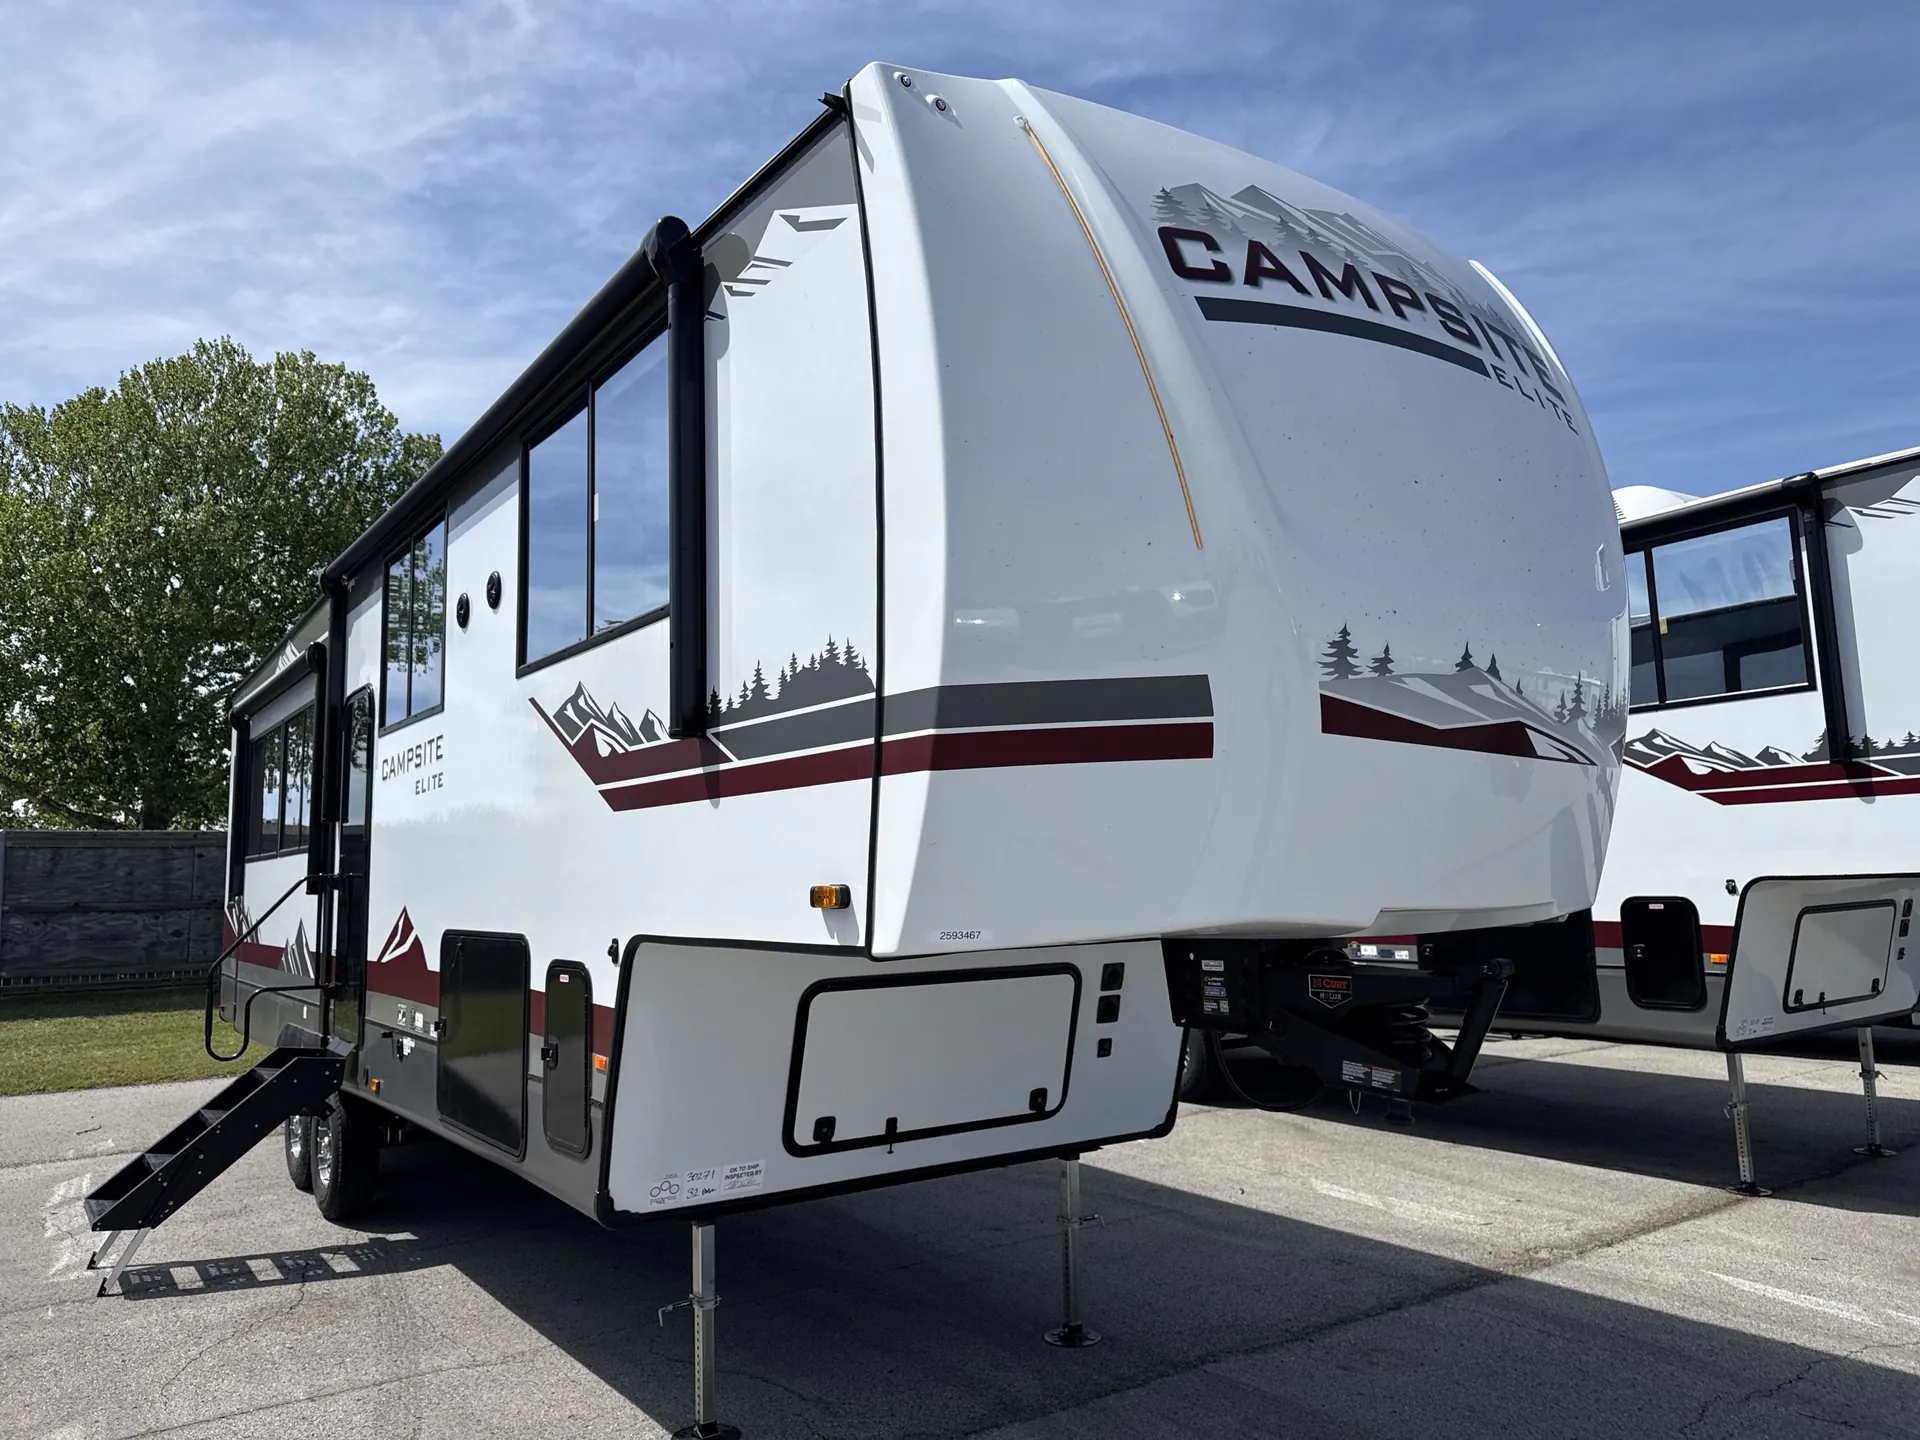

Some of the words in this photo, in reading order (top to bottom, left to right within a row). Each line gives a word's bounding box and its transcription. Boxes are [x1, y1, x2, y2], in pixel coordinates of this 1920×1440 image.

[1157, 226, 1567, 406] CAMPSITE
[1489, 363, 1579, 436] ELITE
[381, 734, 444, 782] CAMPSITE
[415, 771, 444, 796] ELITE
[939, 930, 982, 941] 2593467
[724, 1170, 755, 1180] INSPECTED
[729, 1166, 739, 1174] OK
